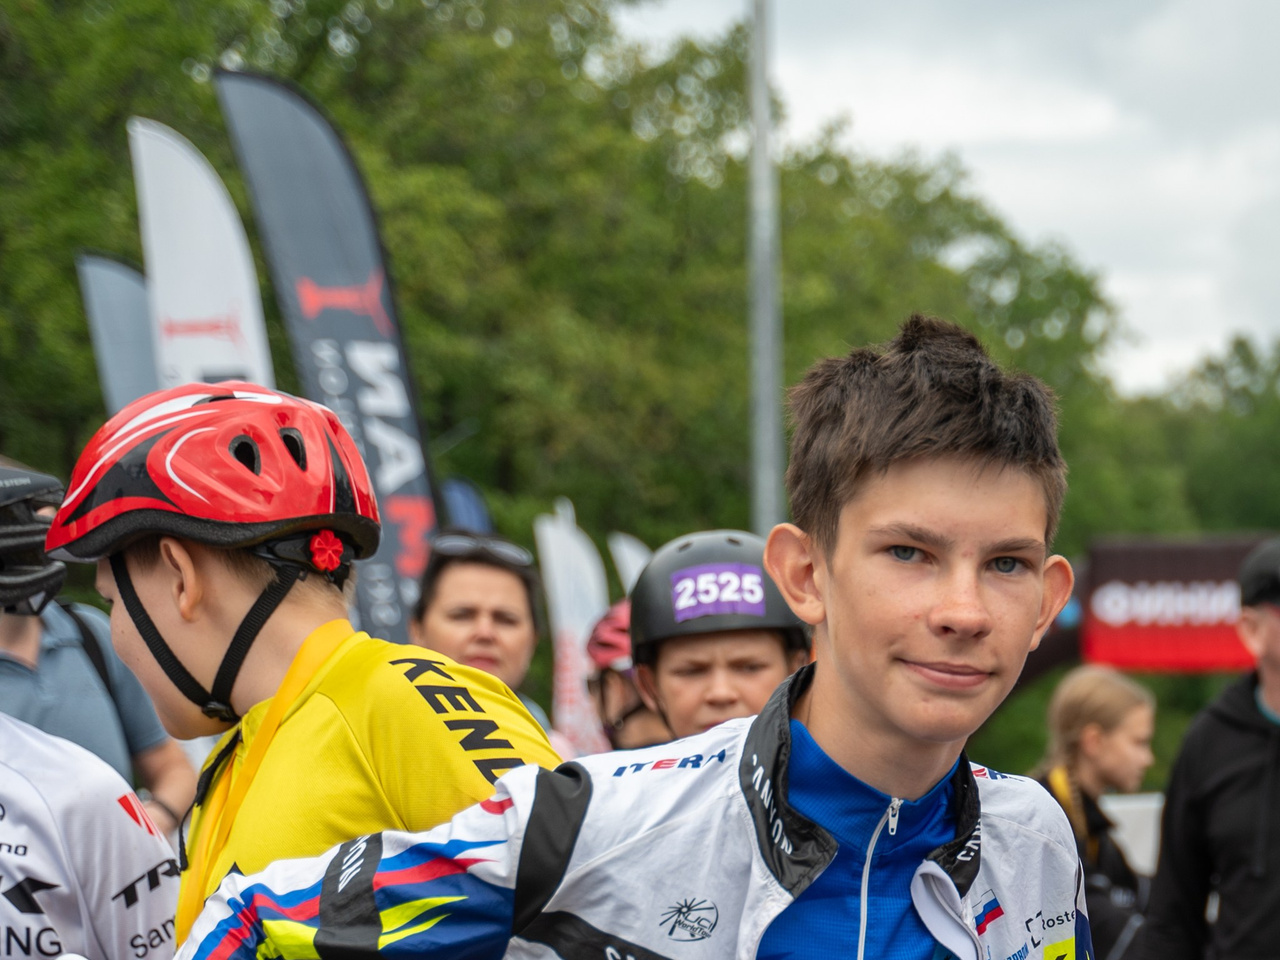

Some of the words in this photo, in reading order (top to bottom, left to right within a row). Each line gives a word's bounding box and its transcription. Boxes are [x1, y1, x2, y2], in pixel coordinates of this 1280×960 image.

[674, 571, 764, 611] 2525
[1090, 580, 1241, 628] ФИНИ
[612, 748, 726, 777] ITERA
[129, 914, 175, 959] San
